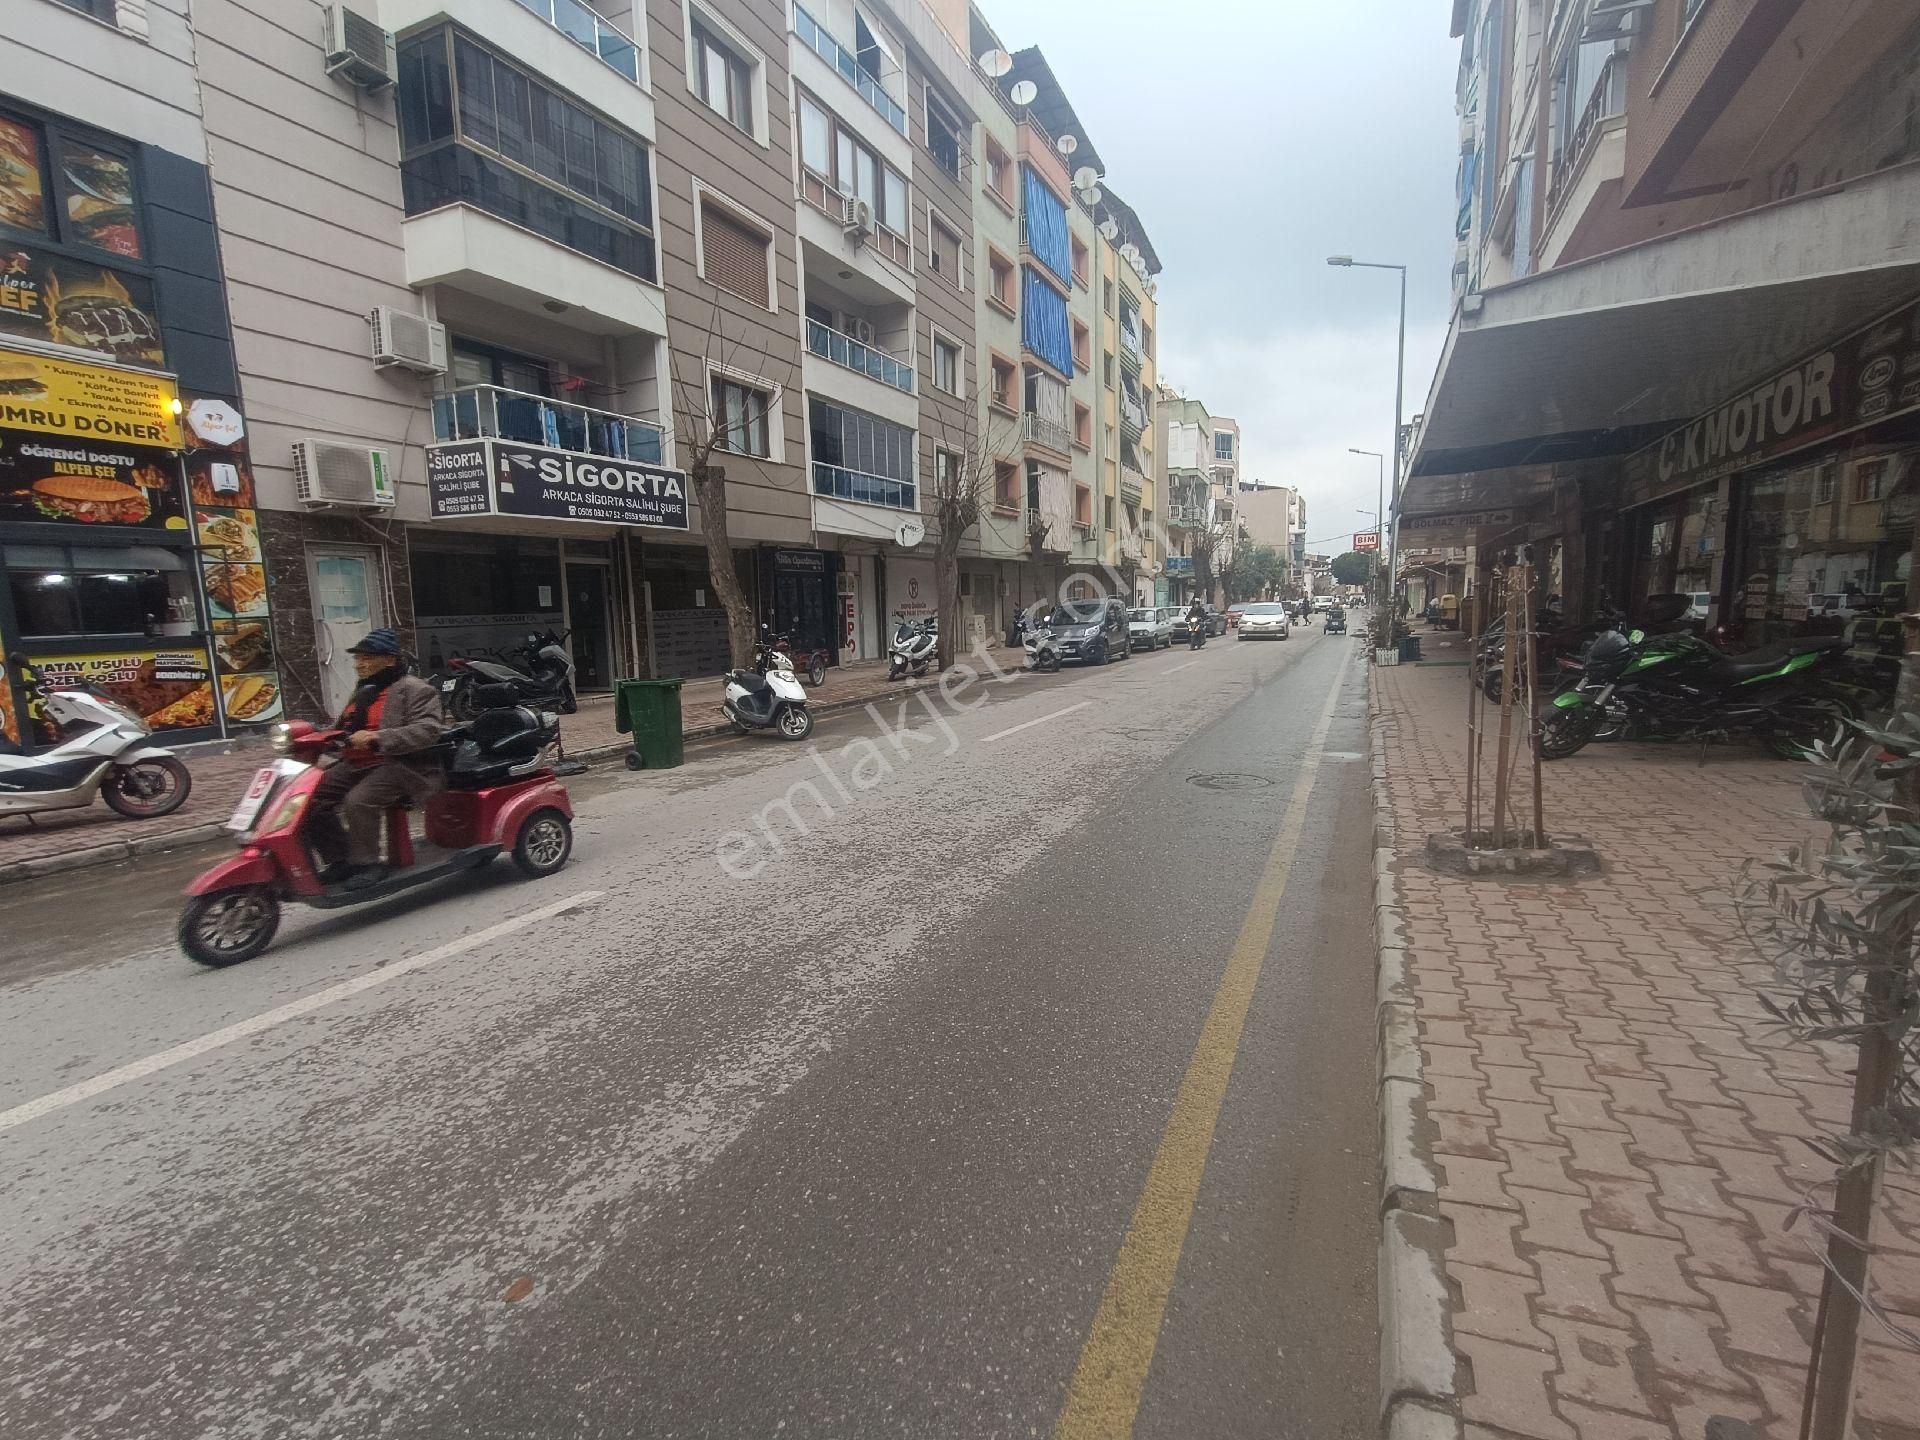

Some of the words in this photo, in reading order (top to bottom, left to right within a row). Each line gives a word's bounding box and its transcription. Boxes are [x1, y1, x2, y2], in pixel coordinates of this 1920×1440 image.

[0, 274, 37, 290] lper
[53, 366, 96, 380] Kumru
[107, 375, 137, 387] Atom
[67, 398, 106, 411] Ekmek
[74, 414, 162, 441] DÖNER
[20, 443, 87, 462] ÖĞRENCİ
[88, 452, 135, 467] DOSTU
[435, 451, 483, 470] SİGORTA
[54, 461, 93, 476] ALPER
[95, 465, 117, 480] ŞEF
[433, 472, 457, 481] ARKACA
[538, 455, 684, 500] SİGORTA
[463, 480, 481, 491] ŞUBE
[542, 488, 584, 503] ARKACA
[585, 491, 625, 507] SİGORTA
[625, 498, 659, 512] SALİHLİ
[660, 502, 682, 514] ŞUBE
[90, 656, 142, 670] USULÜ
[86, 671, 136, 683] SOSLU
